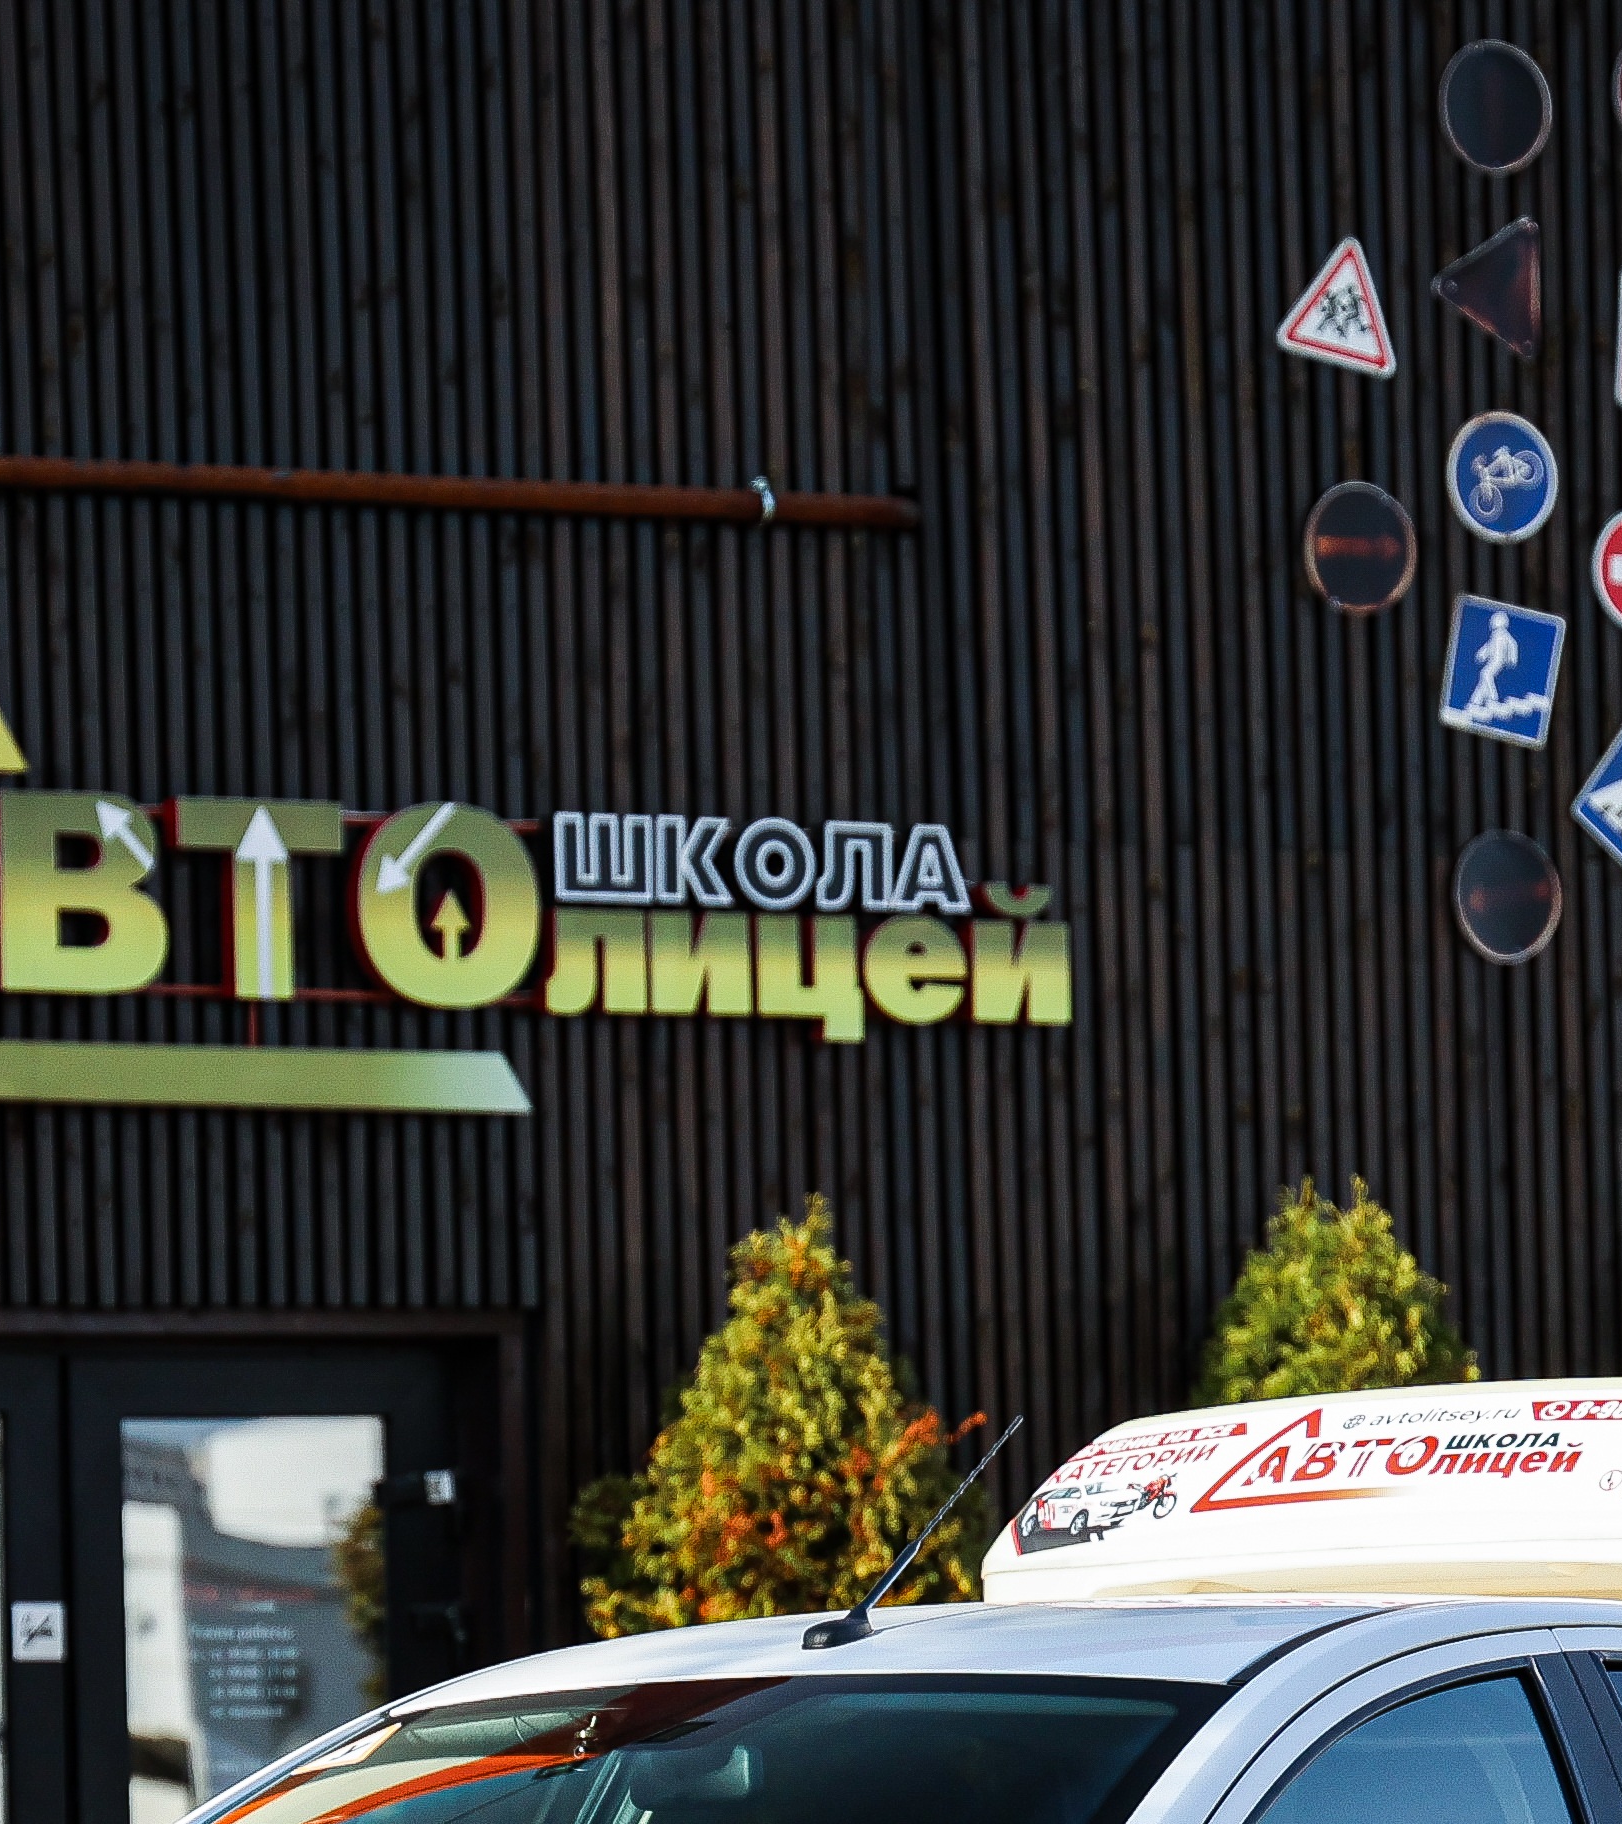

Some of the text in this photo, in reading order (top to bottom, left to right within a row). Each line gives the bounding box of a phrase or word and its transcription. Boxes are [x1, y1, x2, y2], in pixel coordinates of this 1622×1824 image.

[551, 811, 974, 914] ШКОЛА
[1369, 1407, 1522, 1427] avtolitsey.ru
[1445, 1433, 1561, 1450] ШКОЛА
[1047, 1443, 1220, 1486] КАТЕГОРИИ
